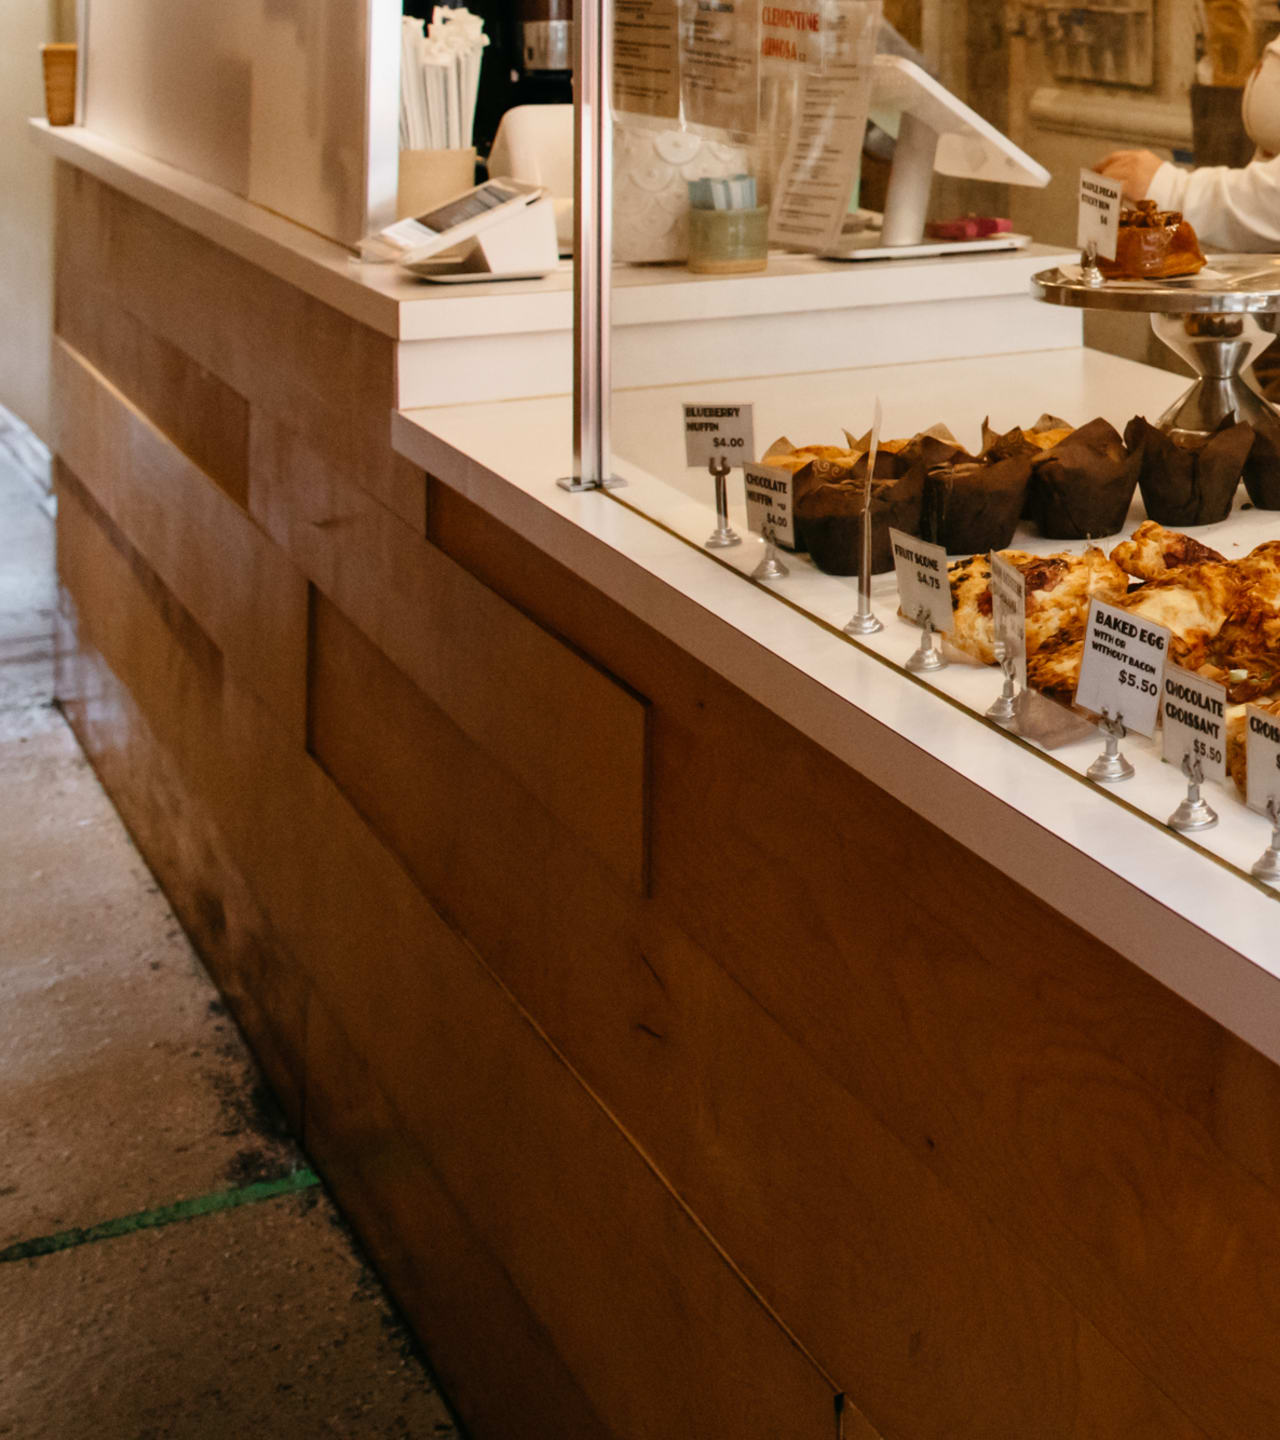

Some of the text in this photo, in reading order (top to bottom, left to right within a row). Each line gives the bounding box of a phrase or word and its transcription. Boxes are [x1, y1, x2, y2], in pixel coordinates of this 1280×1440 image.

[762, 6, 819, 32] CLEMENTINE
[685, 407, 741, 418] BLUEBERRY
[686, 423, 719, 432] MUFFIN
[713, 437, 744, 447] $4.00
[746, 473, 788, 495] CHOCOLATE
[766, 513, 788, 528] $4.00
[894, 543, 939, 572] FRUIT SCONE
[917, 572, 941, 590] $4.75
[1093, 629, 1127, 649] WITH OR
[1095, 610, 1166, 652] BAKED EGG
[1090, 641, 1157, 676] WITHOUT BACON
[1117, 668, 1159, 698] $5.50
[1165, 677, 1225, 719] CHOCOLATE
[1164, 700, 1221, 740] CROISSANT
[1192, 738, 1222, 765] $5.50
